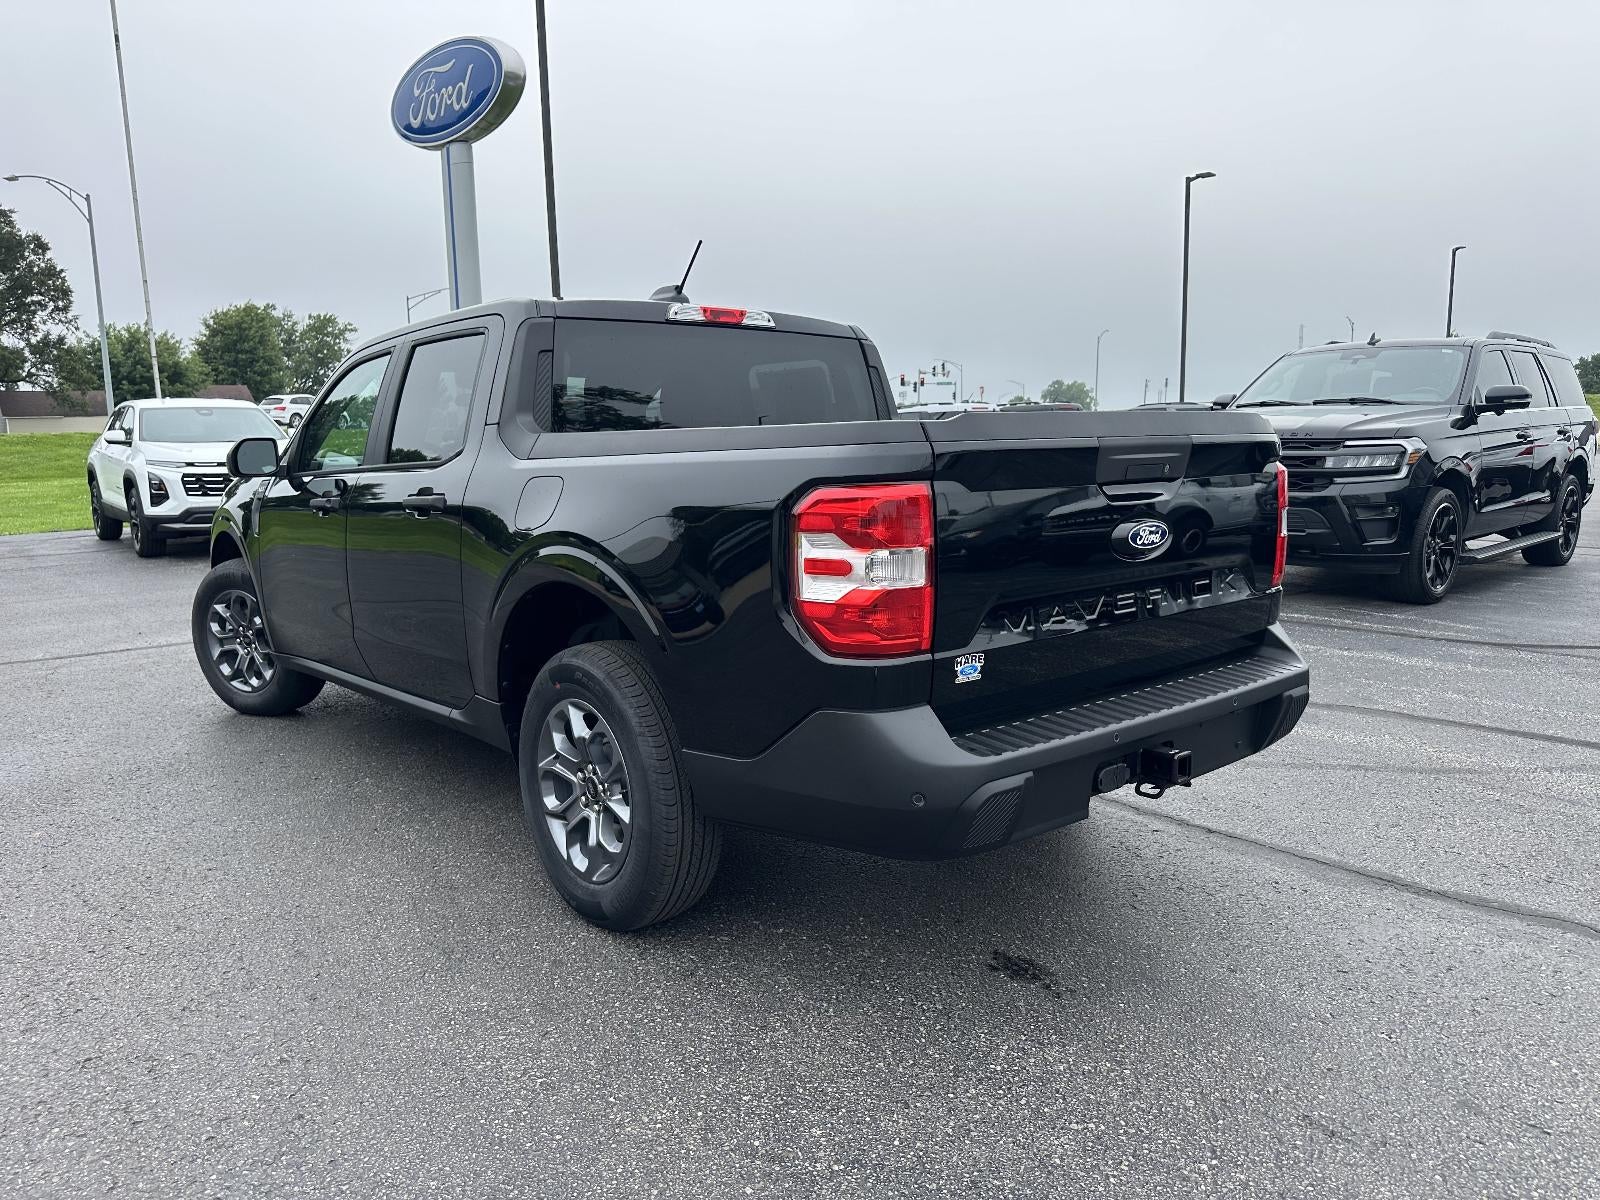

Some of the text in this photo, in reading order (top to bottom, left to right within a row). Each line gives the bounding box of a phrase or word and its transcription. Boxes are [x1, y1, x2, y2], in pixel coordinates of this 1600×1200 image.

[409, 58, 474, 129] Ford
[1136, 526, 1162, 545] Ford
[1000, 568, 1238, 636] MAVERICK
[955, 653, 985, 670] HARE
